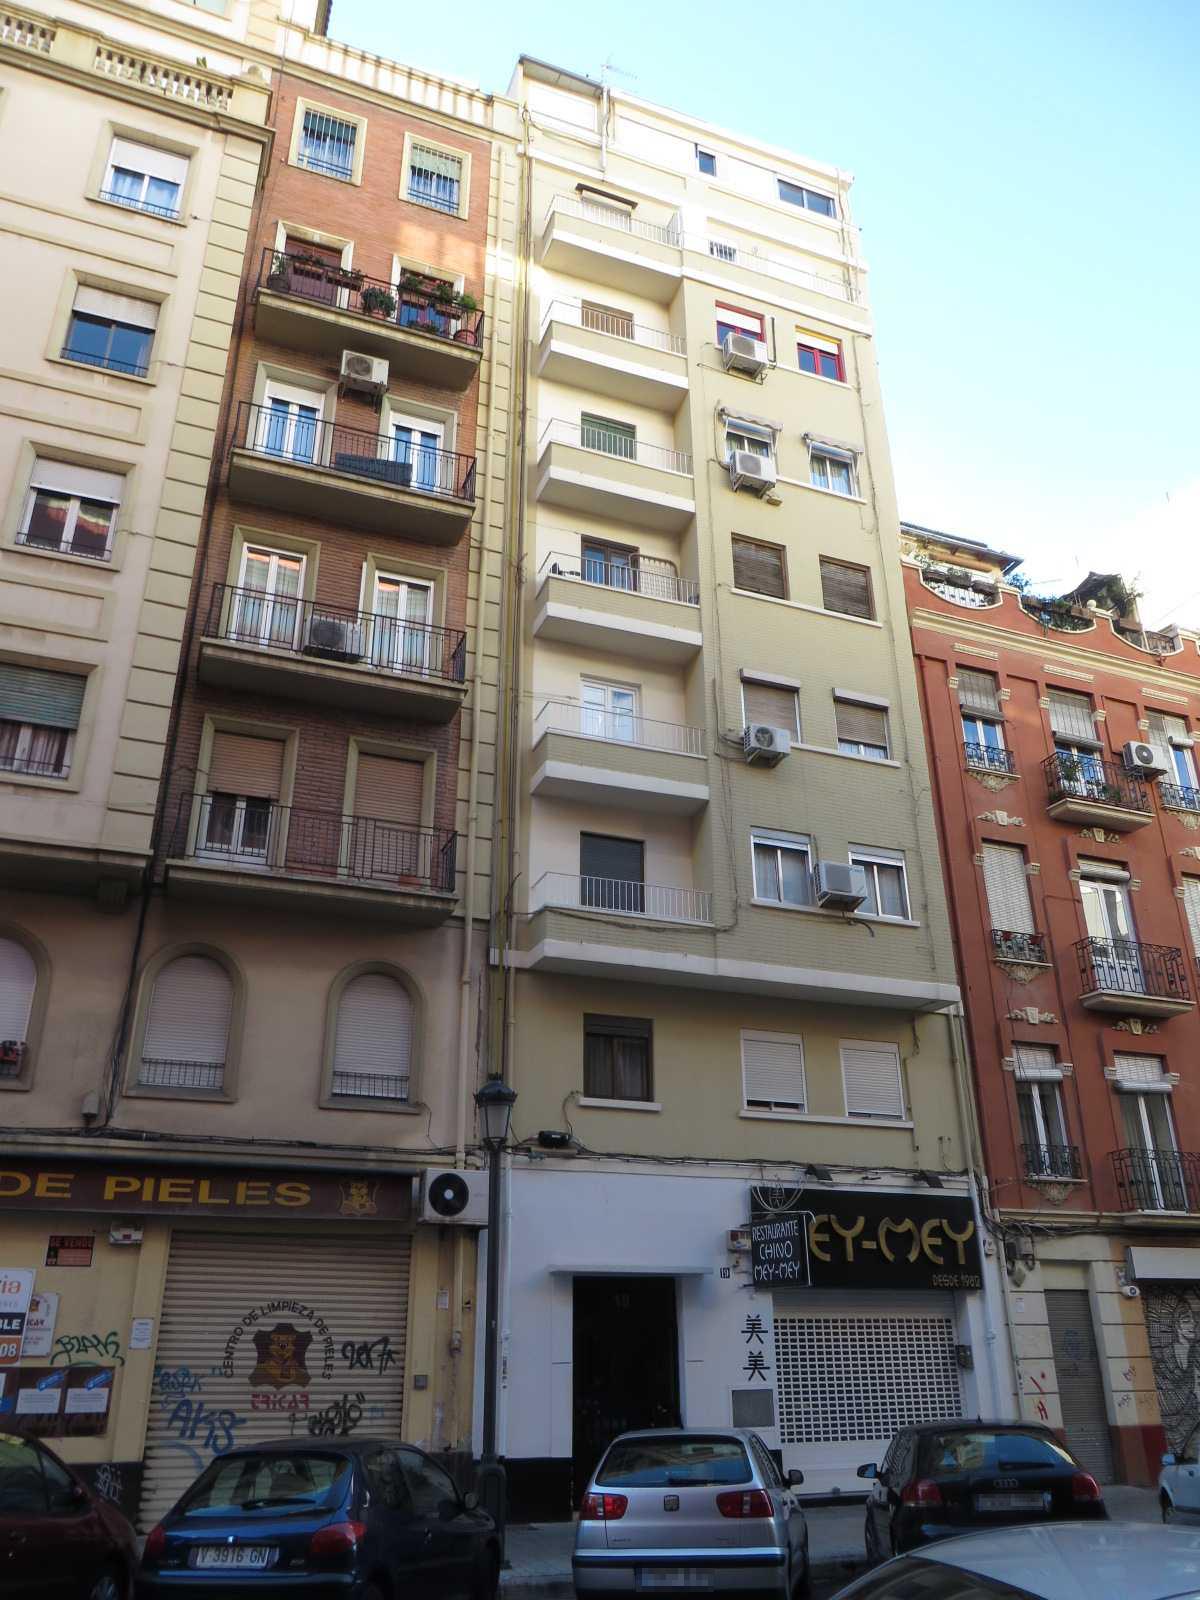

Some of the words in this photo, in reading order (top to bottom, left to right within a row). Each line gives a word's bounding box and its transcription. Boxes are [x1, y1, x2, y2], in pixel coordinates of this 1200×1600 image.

[103, 1176, 311, 1206] PIELES
[752, 1220, 799, 1242] RESTAURANTE
[808, 1214, 974, 1264] EY-MEY
[760, 1241, 792, 1260] CHINO
[755, 1261, 799, 1280] MEY-MEY
[932, 1274, 959, 1287] DESDE
[223, 1326, 243, 1378] CENTRO
[242, 1309, 258, 1326] DE
[260, 1300, 314, 1320] LIMPIEZA
[314, 1319, 328, 1335] DE
[322, 1336, 334, 1380] PIELES
